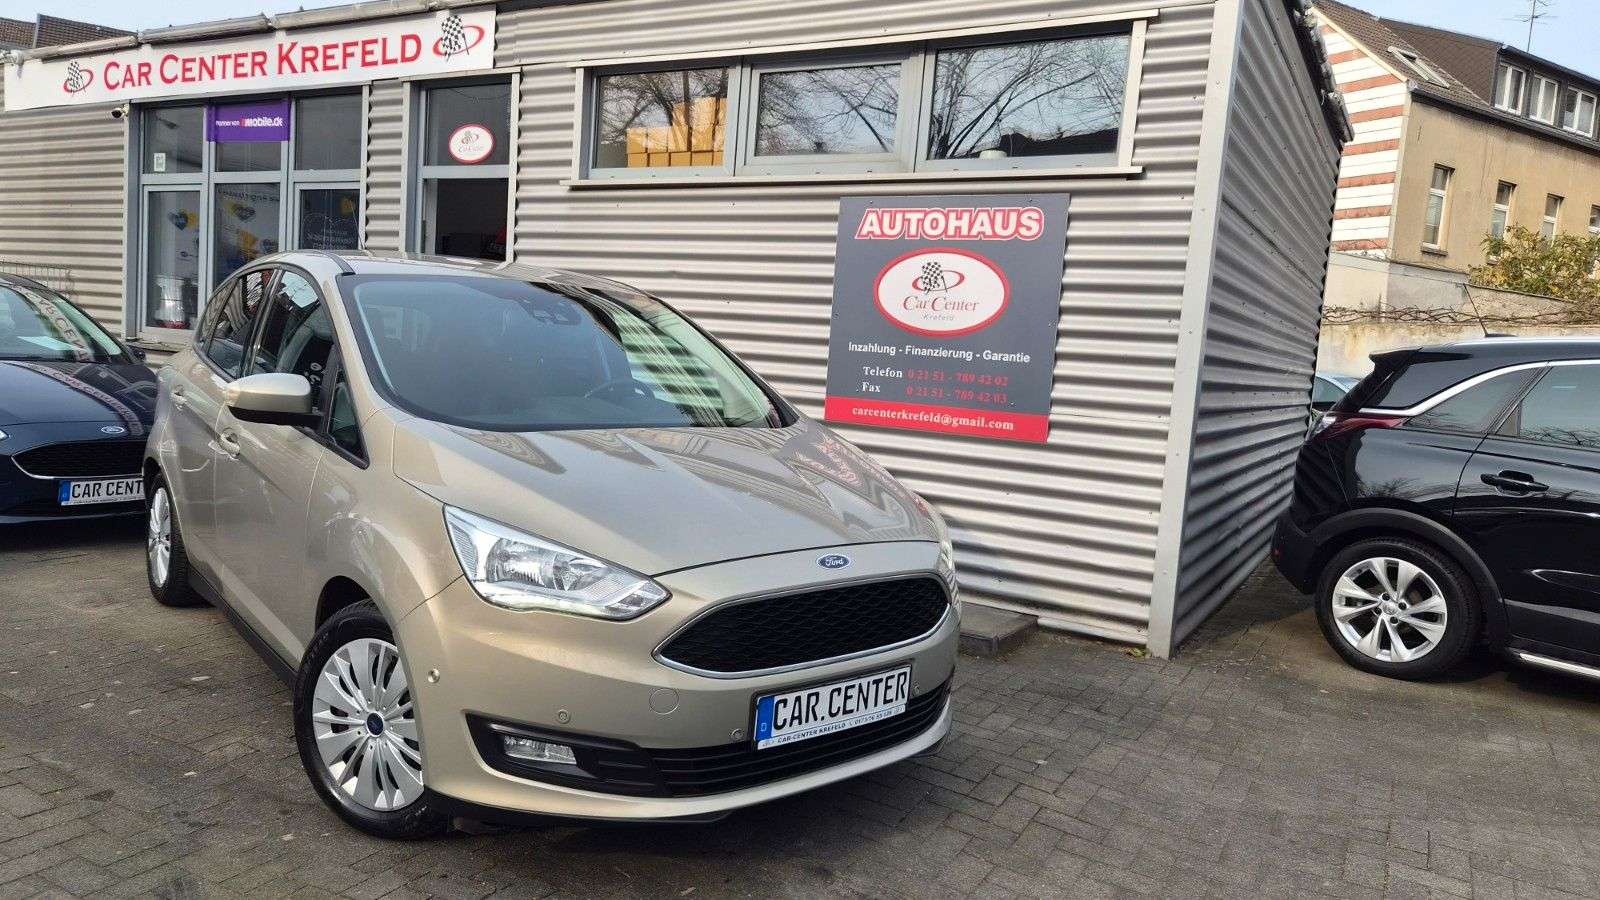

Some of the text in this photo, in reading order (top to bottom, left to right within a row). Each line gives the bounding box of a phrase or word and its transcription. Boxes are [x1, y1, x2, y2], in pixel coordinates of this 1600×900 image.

[104, 33, 422, 90] CAR CENTER KREFELD
[855, 207, 1044, 241] AUTOHAUS
[849, 341, 896, 356] Inzahlung
[905, 345, 973, 362] Finanzierung
[983, 350, 1030, 363] Garantie
[863, 366, 903, 379] Telefon
[862, 381, 881, 393] Fax
[852, 406, 1014, 431] carcenterkrefeld@gmail.com
[72, 483, 102, 498] CAR
